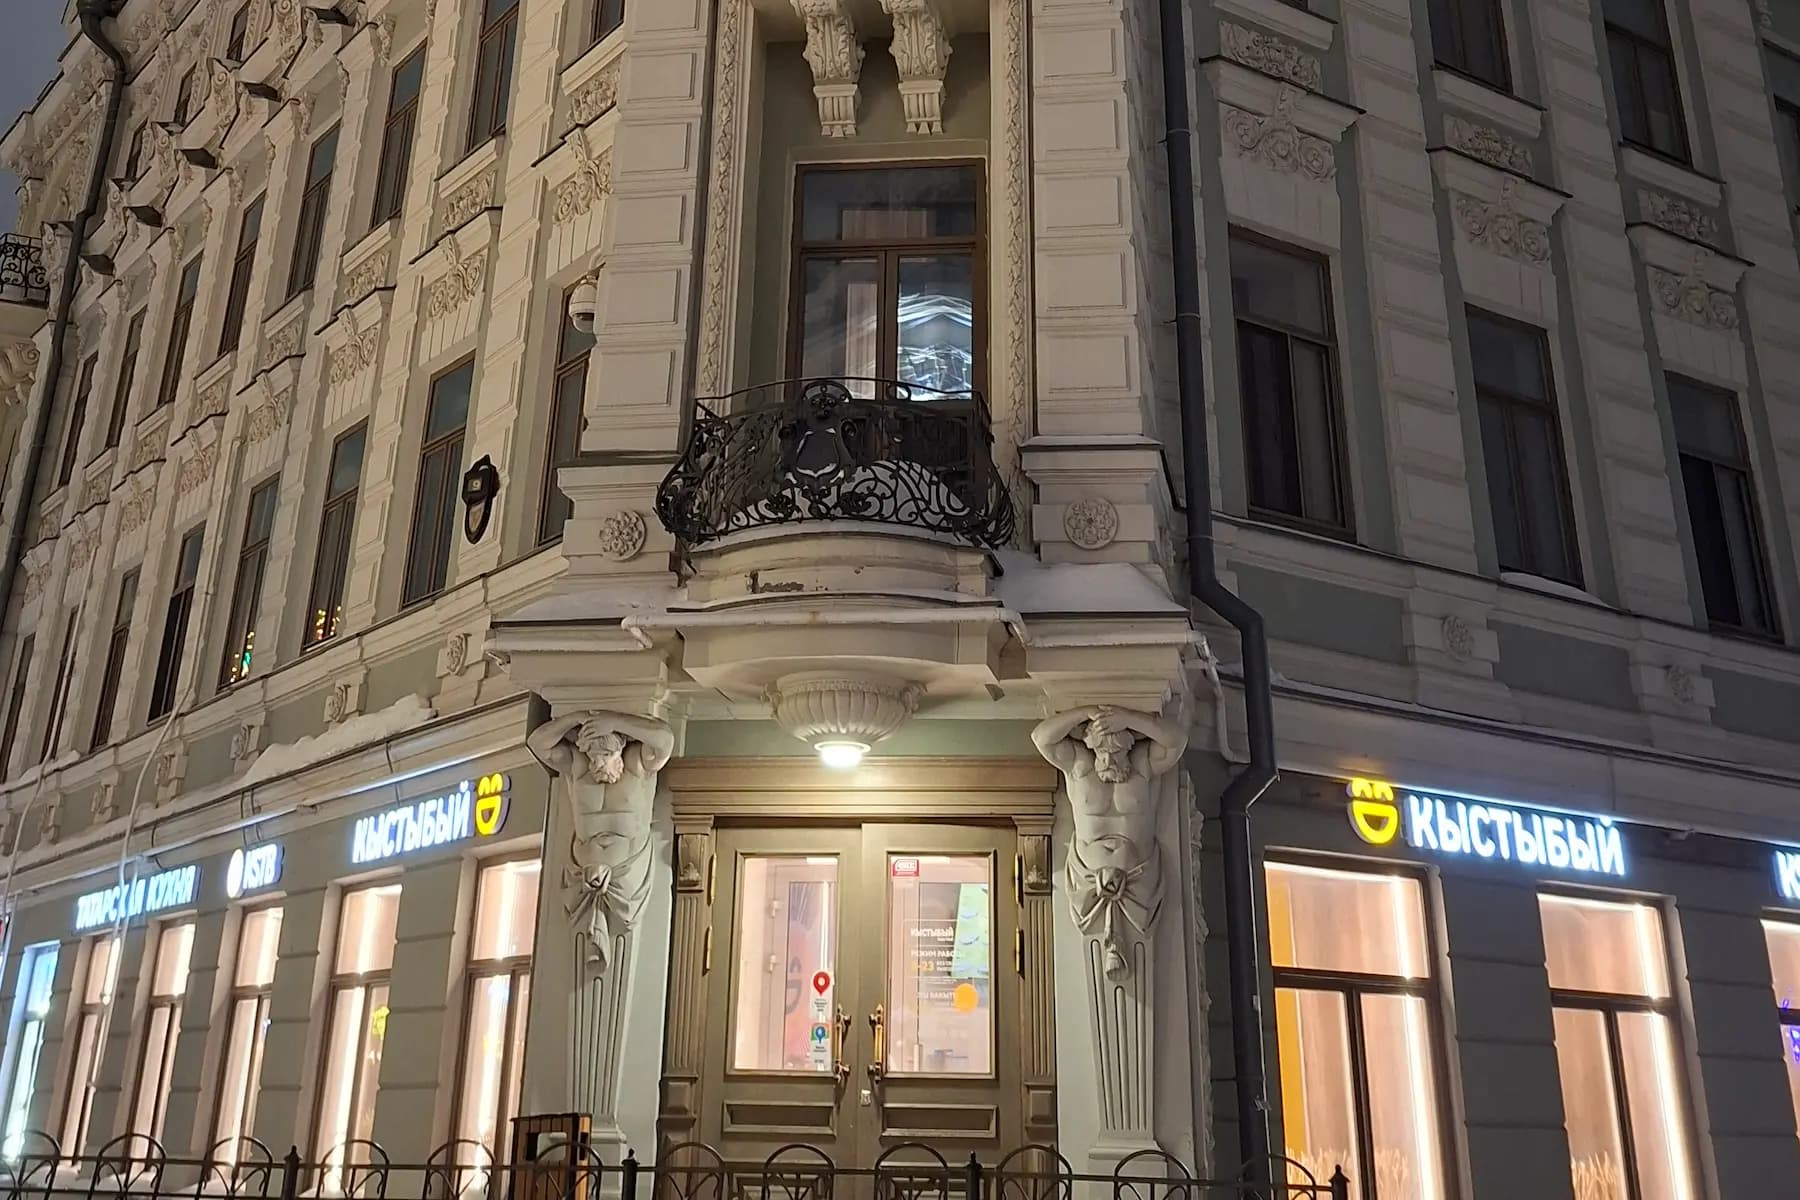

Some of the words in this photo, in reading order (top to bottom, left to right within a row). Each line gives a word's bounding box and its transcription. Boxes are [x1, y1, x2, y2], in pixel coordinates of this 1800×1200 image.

[352, 780, 471, 863] КЫСТЫБЫЙ
[1408, 794, 1625, 876] КЫСТЫБЫЙ
[147, 865, 197, 911] КУХНЯ
